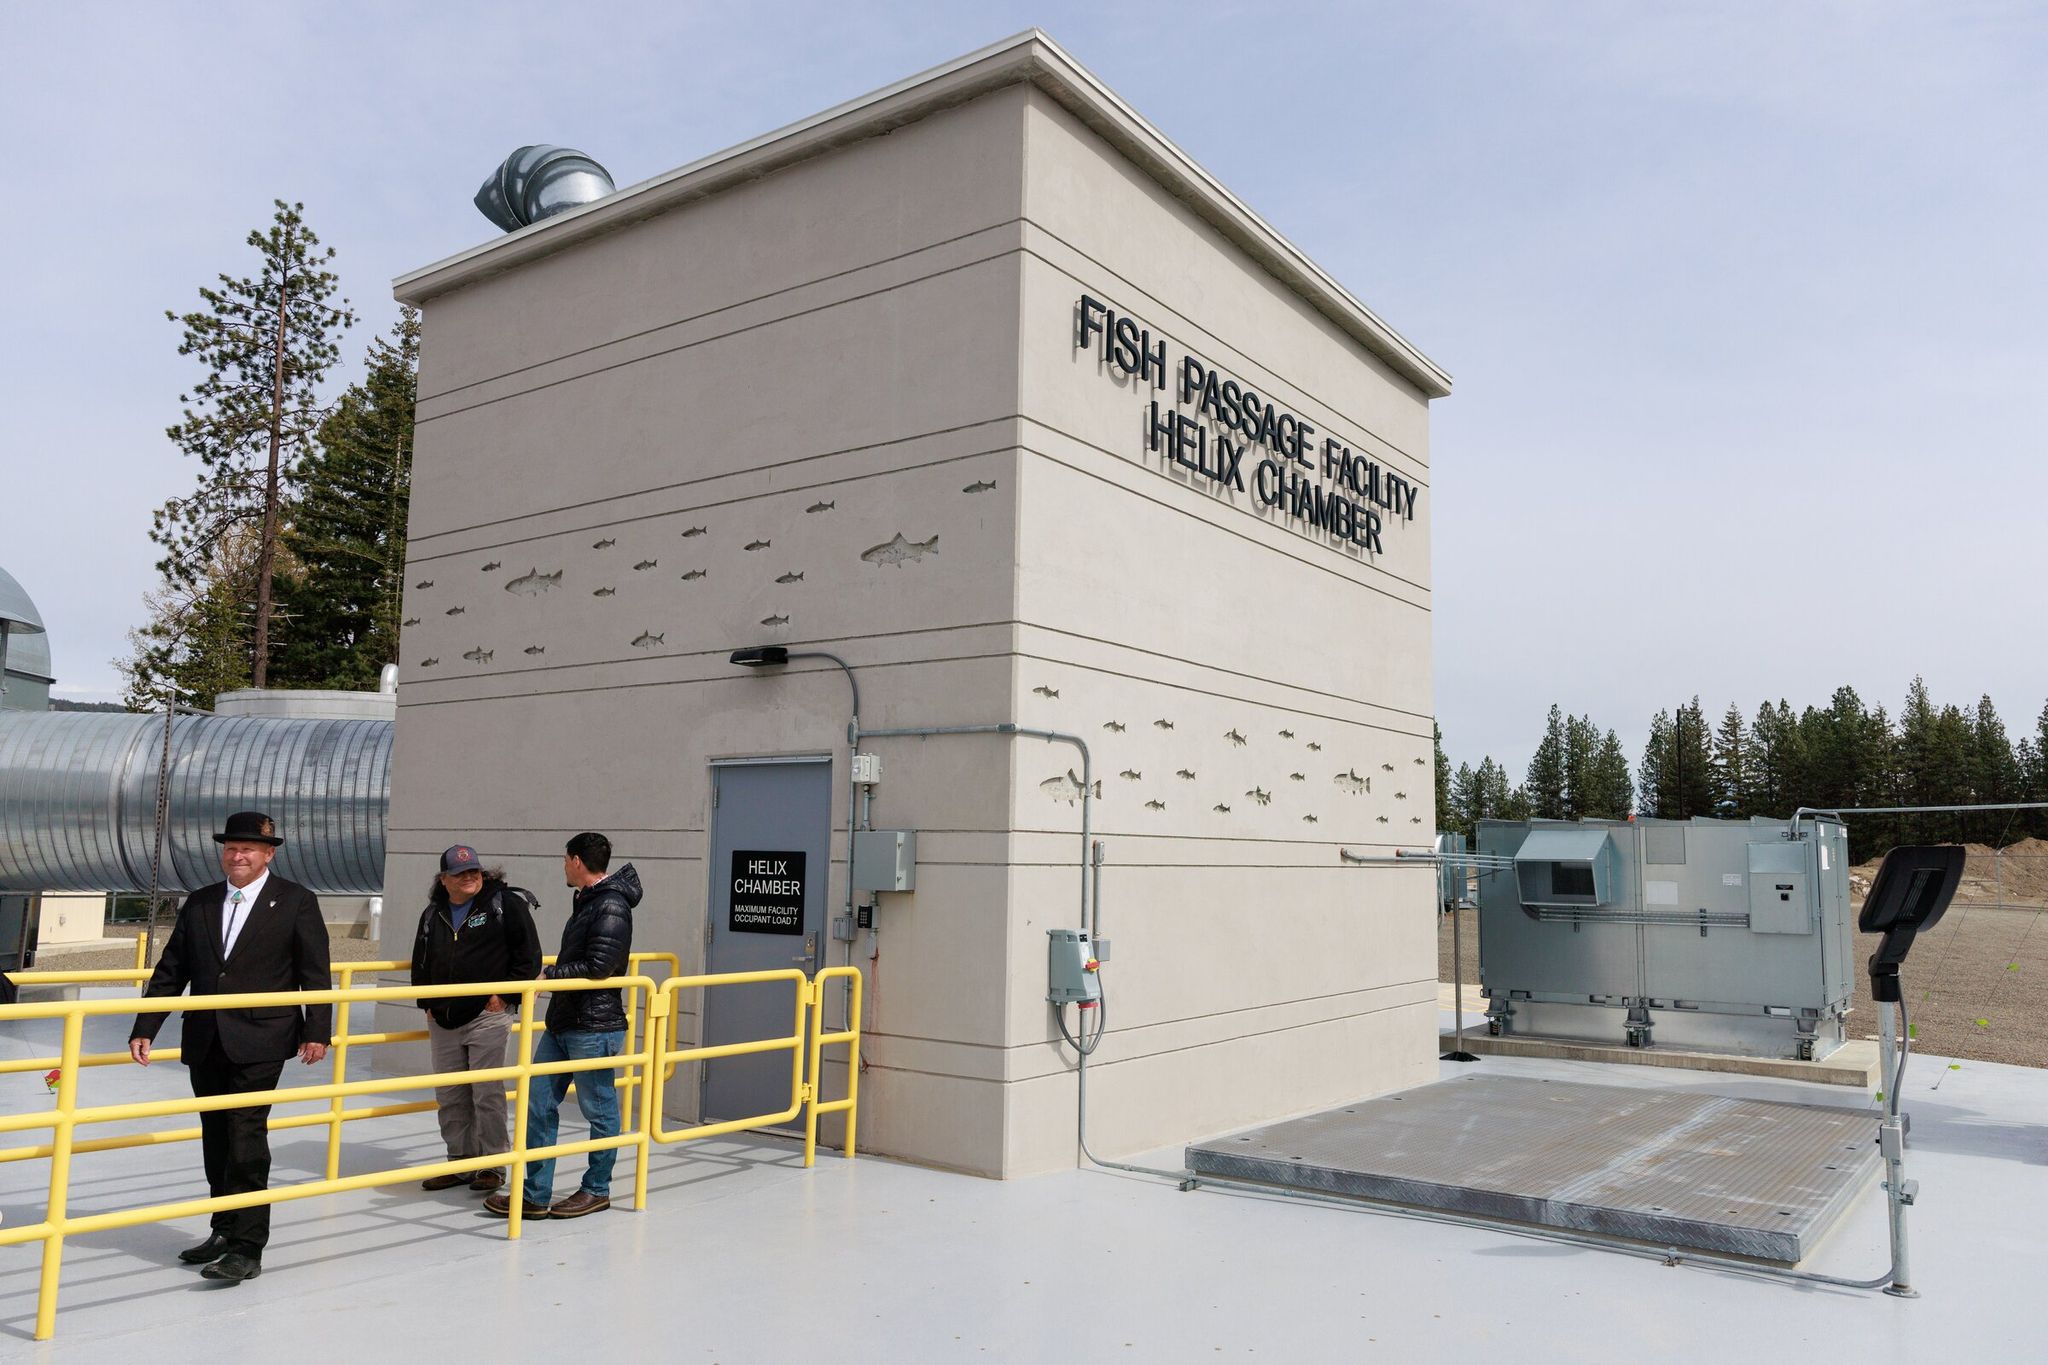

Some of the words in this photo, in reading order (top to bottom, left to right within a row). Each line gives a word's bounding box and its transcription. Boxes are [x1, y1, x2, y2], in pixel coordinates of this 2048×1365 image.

[1080, 294, 1166, 390] FISH
[1183, 355, 1315, 470] PASSAGE
[1325, 437, 1418, 521] FACILITY
[1150, 400, 1245, 492] HELIX
[1257, 459, 1383, 554] CHAMBER
[749, 860, 787, 875] HELIX
[734, 879, 800, 895] CHAMBER
[735, 905, 767, 913] MAXIMUM
[768, 906, 798, 915] FACILITY
[735, 914, 771, 923] OCCUPANT
[793, 917, 798, 925] 7
